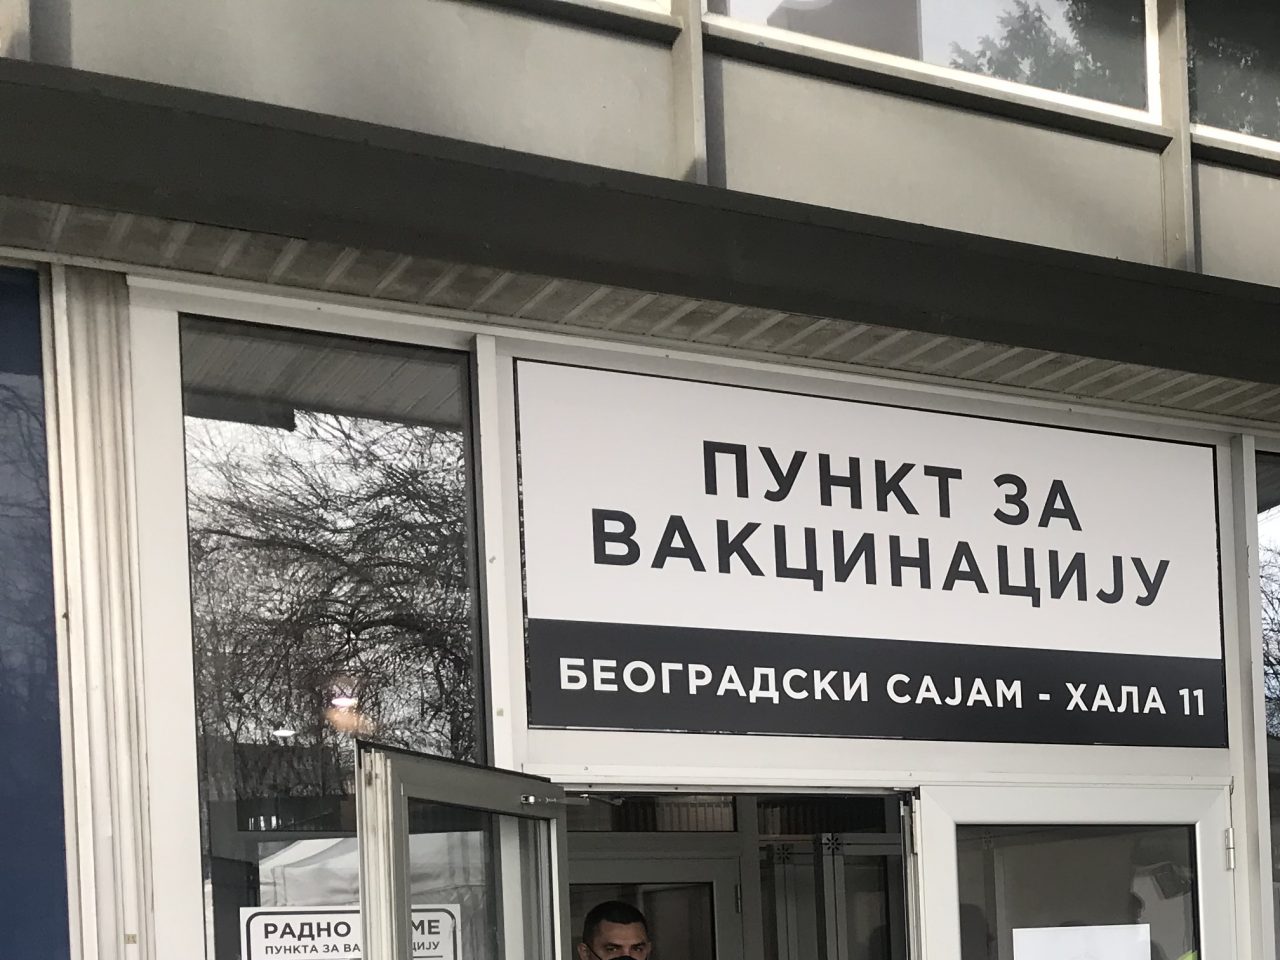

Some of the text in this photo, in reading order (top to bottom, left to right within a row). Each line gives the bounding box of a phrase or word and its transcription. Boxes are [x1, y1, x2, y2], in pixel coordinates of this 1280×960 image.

[702, 439, 1083, 532] ПУНКТ ЗА
[591, 508, 1171, 609] ВАКЦИНАЦИЈУ
[558, 656, 870, 704] БЕОГРАДСКИ
[886, 673, 1024, 710] САЈАМ
[1066, 681, 1167, 717] ХАЛА
[1178, 687, 1206, 717] 11
[263, 920, 352, 942] РАДНО
[265, 943, 319, 955] ПУНКТА
[322, 943, 340, 953] ЗА
